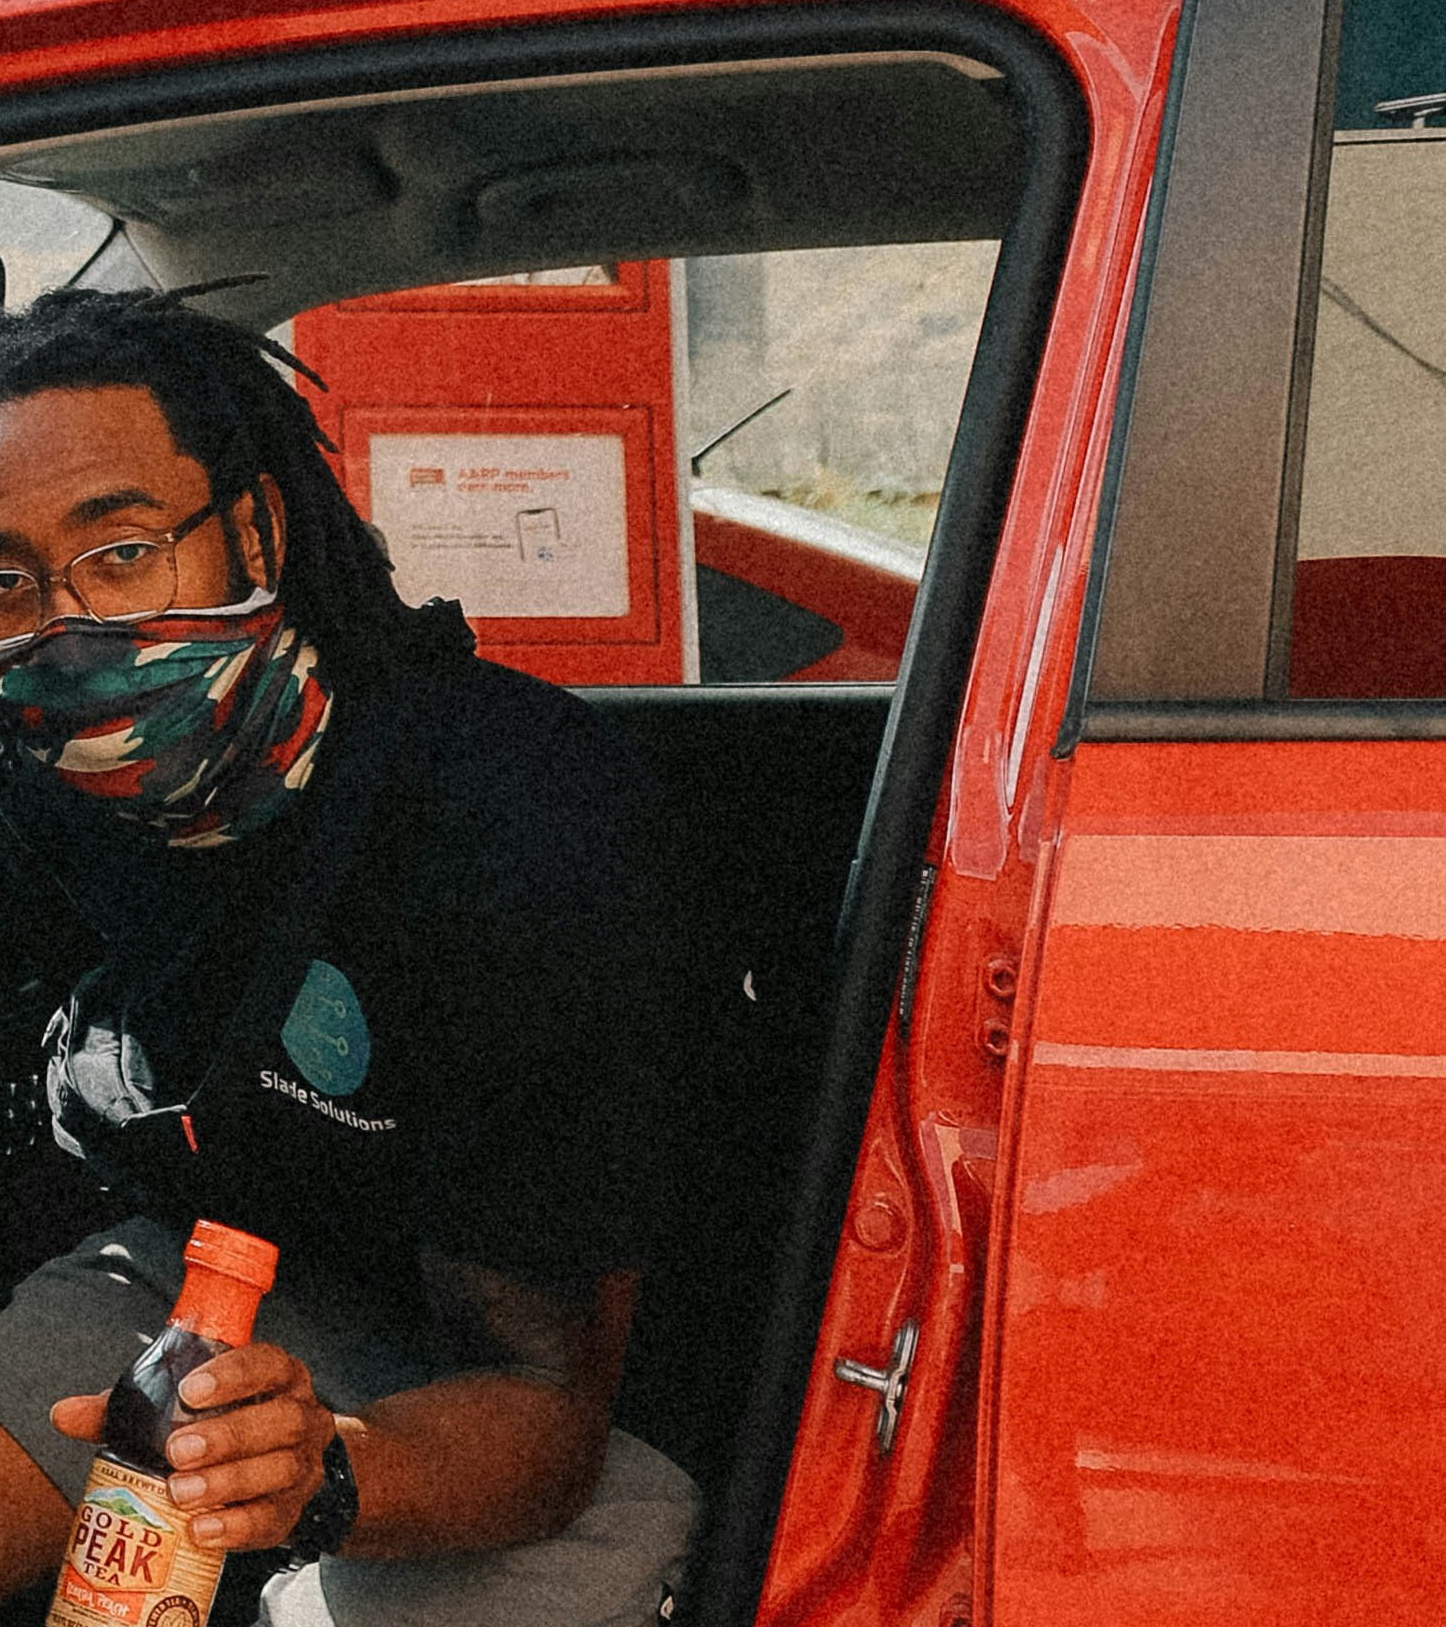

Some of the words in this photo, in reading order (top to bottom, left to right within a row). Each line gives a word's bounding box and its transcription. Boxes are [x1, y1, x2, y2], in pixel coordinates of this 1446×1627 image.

[310, 1091, 397, 1131] Solutions
[81, 1505, 162, 1547] GOLD
[71, 1523, 158, 1583] PEAK
[83, 1560, 121, 1586] TEA
